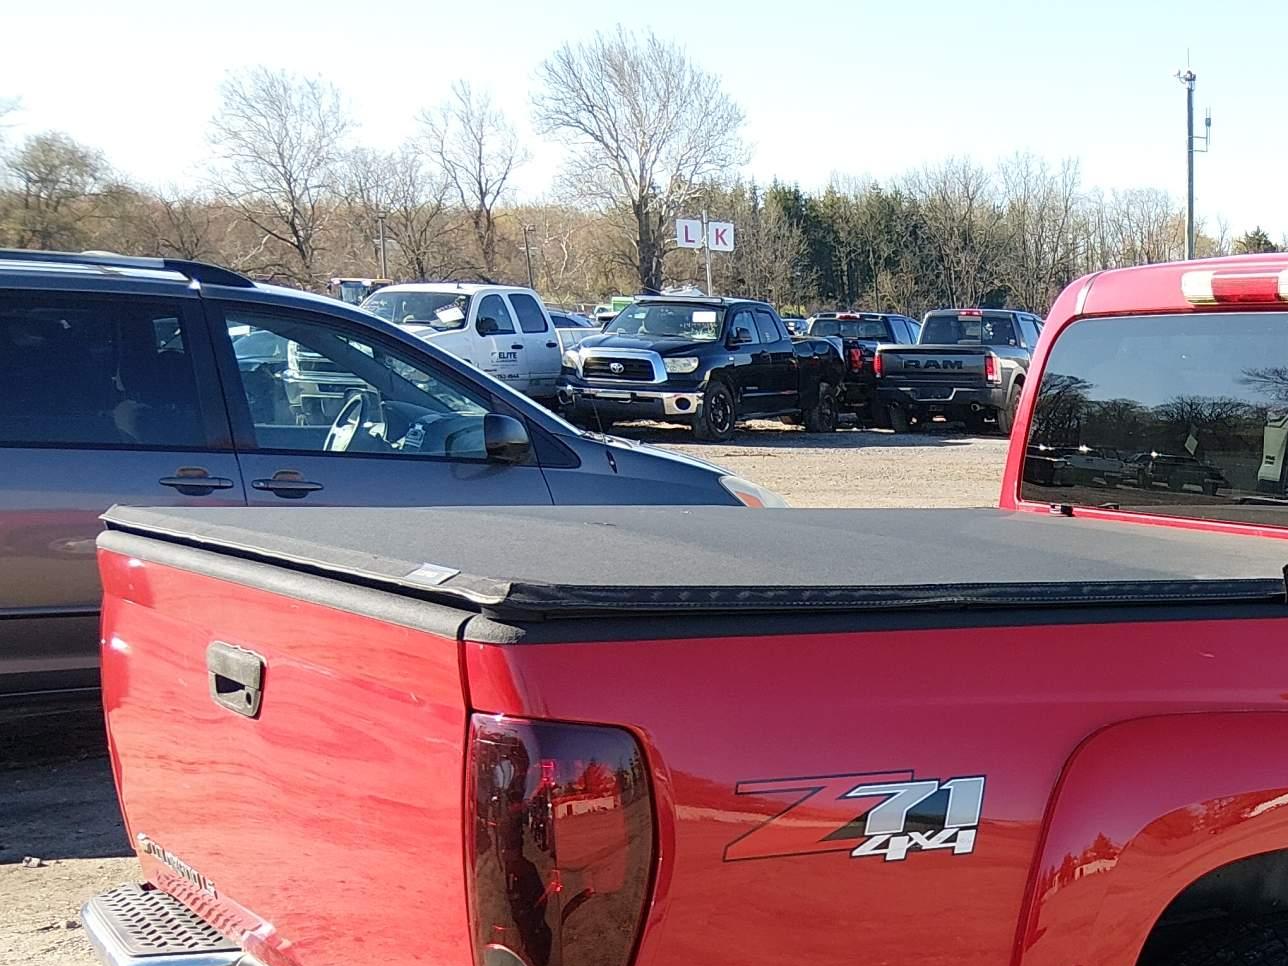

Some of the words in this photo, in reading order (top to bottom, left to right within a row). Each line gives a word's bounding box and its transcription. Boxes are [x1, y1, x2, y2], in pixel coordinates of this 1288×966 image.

[684, 225, 696, 243] L
[715, 227, 729, 246] K
[498, 351, 518, 359] ELITE
[903, 359, 963, 370] RAM
[722, 769, 987, 863] Z71
